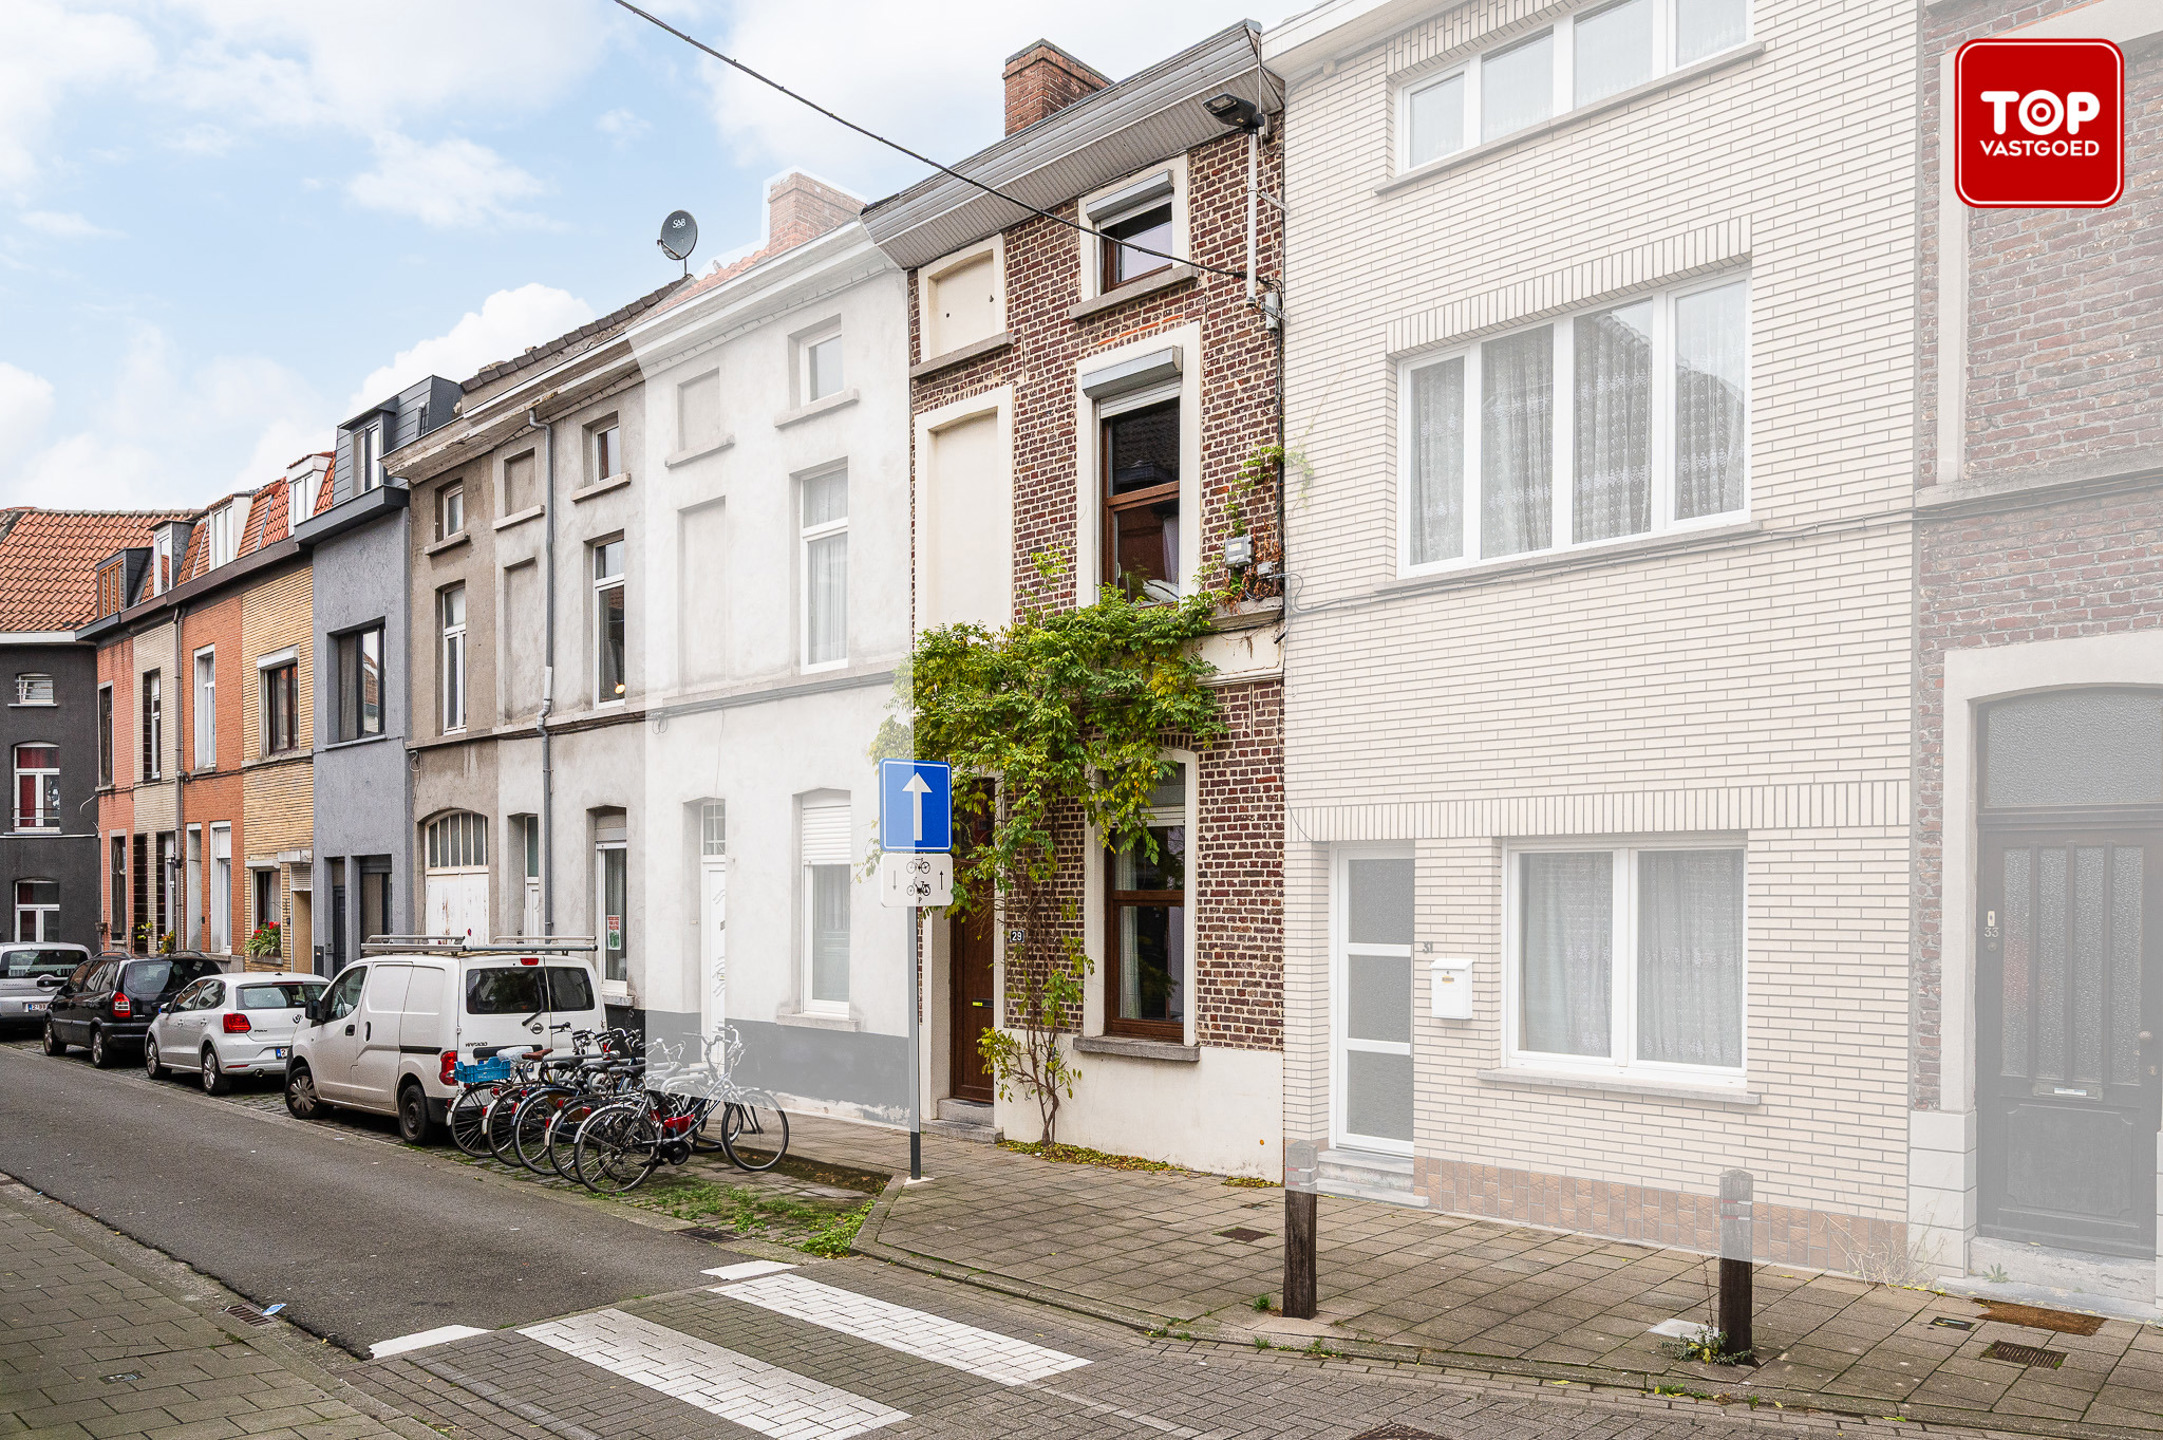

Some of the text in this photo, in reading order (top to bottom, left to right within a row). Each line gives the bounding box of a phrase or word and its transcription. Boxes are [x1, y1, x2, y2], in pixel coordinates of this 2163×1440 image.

[1012, 931, 1022, 941] 29
[1984, 926, 1999, 938] 33
[1422, 941, 1433, 954] 31
